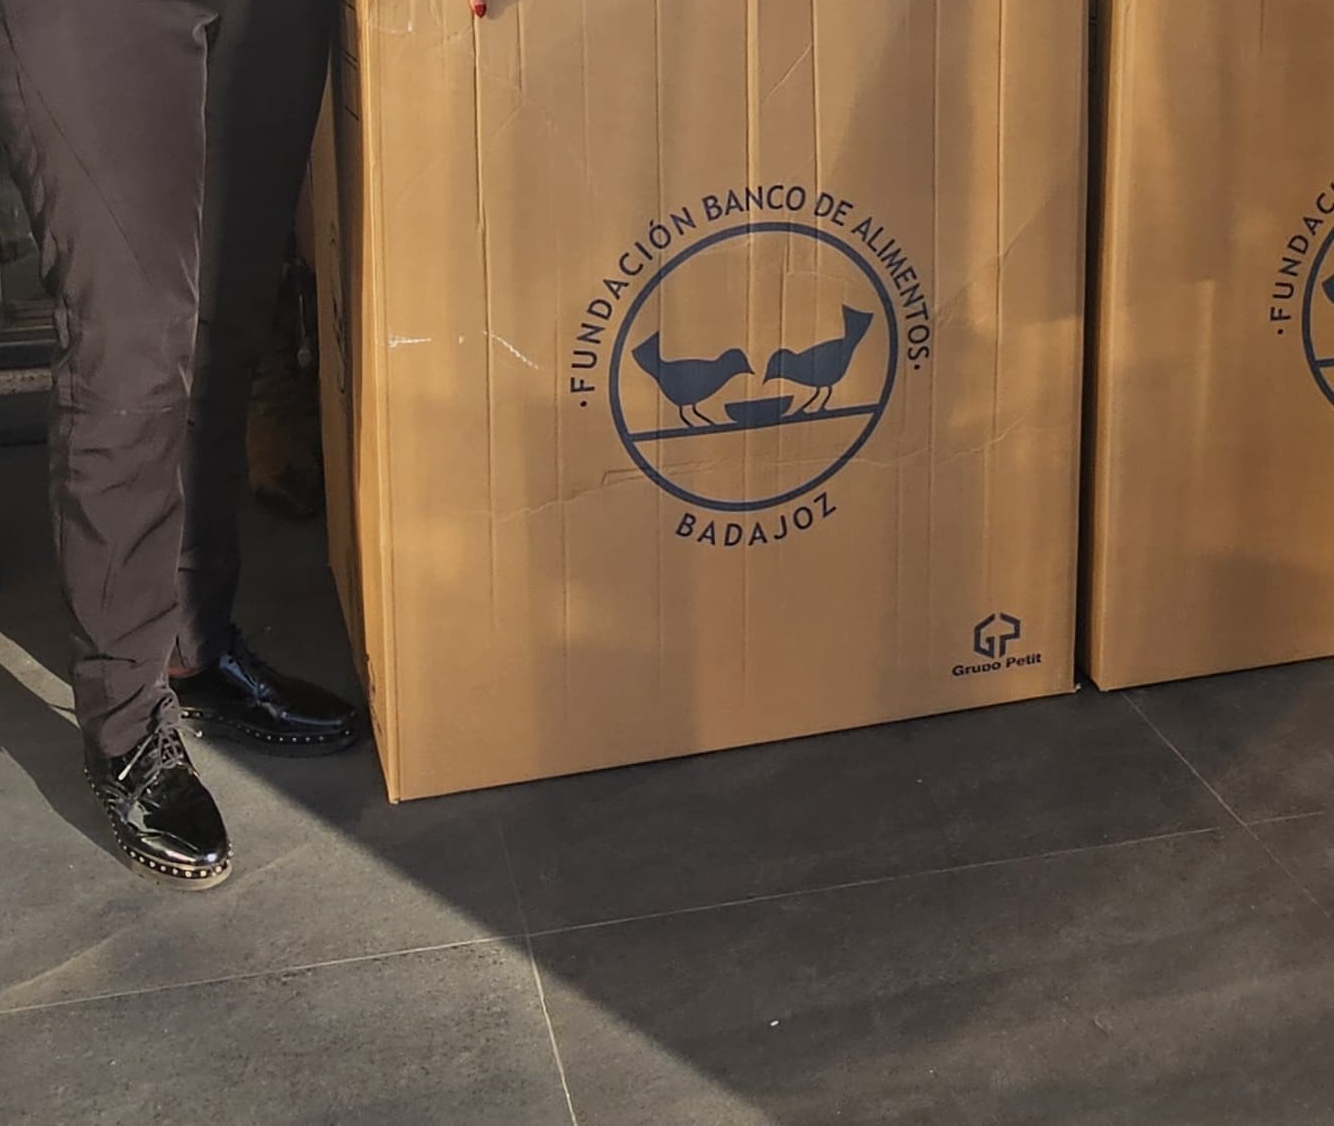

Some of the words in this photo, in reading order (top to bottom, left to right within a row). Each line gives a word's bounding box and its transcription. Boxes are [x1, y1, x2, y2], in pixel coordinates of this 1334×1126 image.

[570, 206, 697, 394] FUNDACIÓN
[702, 185, 806, 222] BANCO
[814, 192, 854, 226] DE
[852, 217, 930, 362] ALIMENTOS
[675, 492, 837, 547] BADAJOZ
[1005, 653, 1042, 668] Petit
